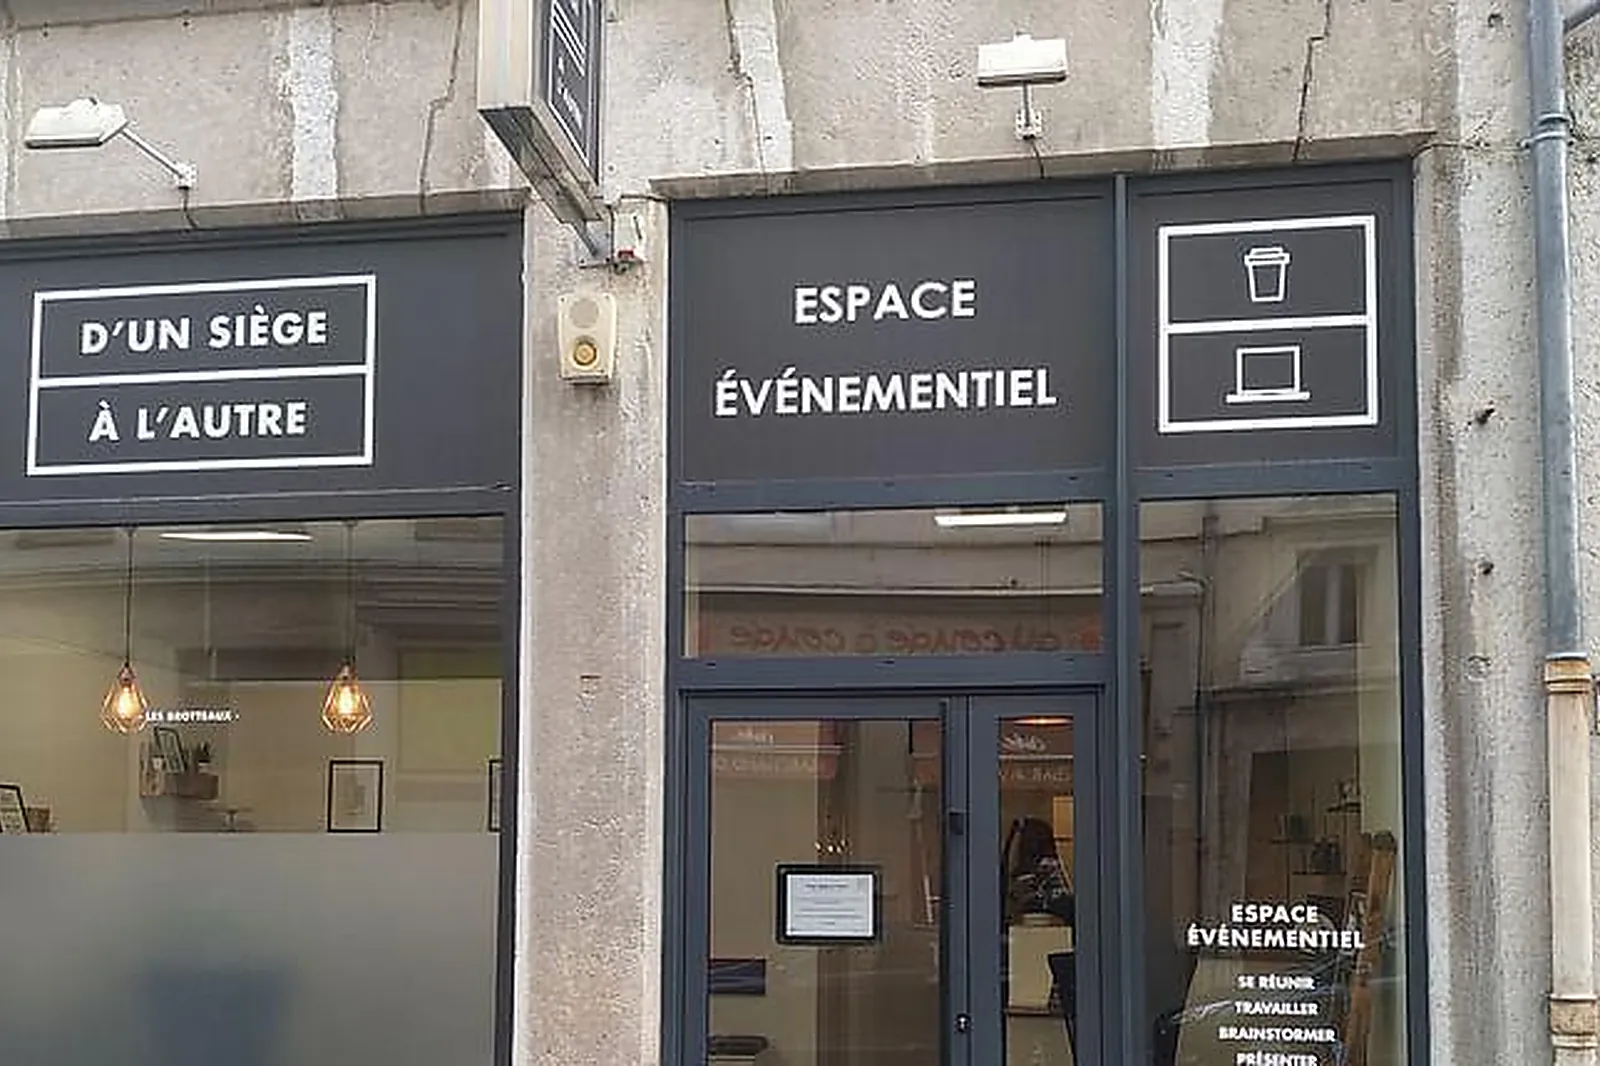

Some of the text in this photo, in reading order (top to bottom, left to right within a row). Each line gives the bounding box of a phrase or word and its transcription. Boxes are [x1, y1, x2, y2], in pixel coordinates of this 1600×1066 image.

[795, 281, 976, 324] ESPACE
[208, 304, 328, 348] SIÈGE
[714, 367, 1058, 417] ÉVÉNEMENTIEL
[88, 400, 119, 442] À
[144, 711, 232, 722] LES BROTTEAUX
[1231, 903, 1319, 924] ESPACE
[1187, 923, 1366, 949] ÉVÉNEMENTIEL
[1238, 973, 1315, 990] SE RÉUNIR
[1234, 1001, 1319, 1015] TRAVAILLER
[1218, 1027, 1336, 1042] BRAINSTORMER
[1236, 1050, 1319, 1066] PRÉSENTER
